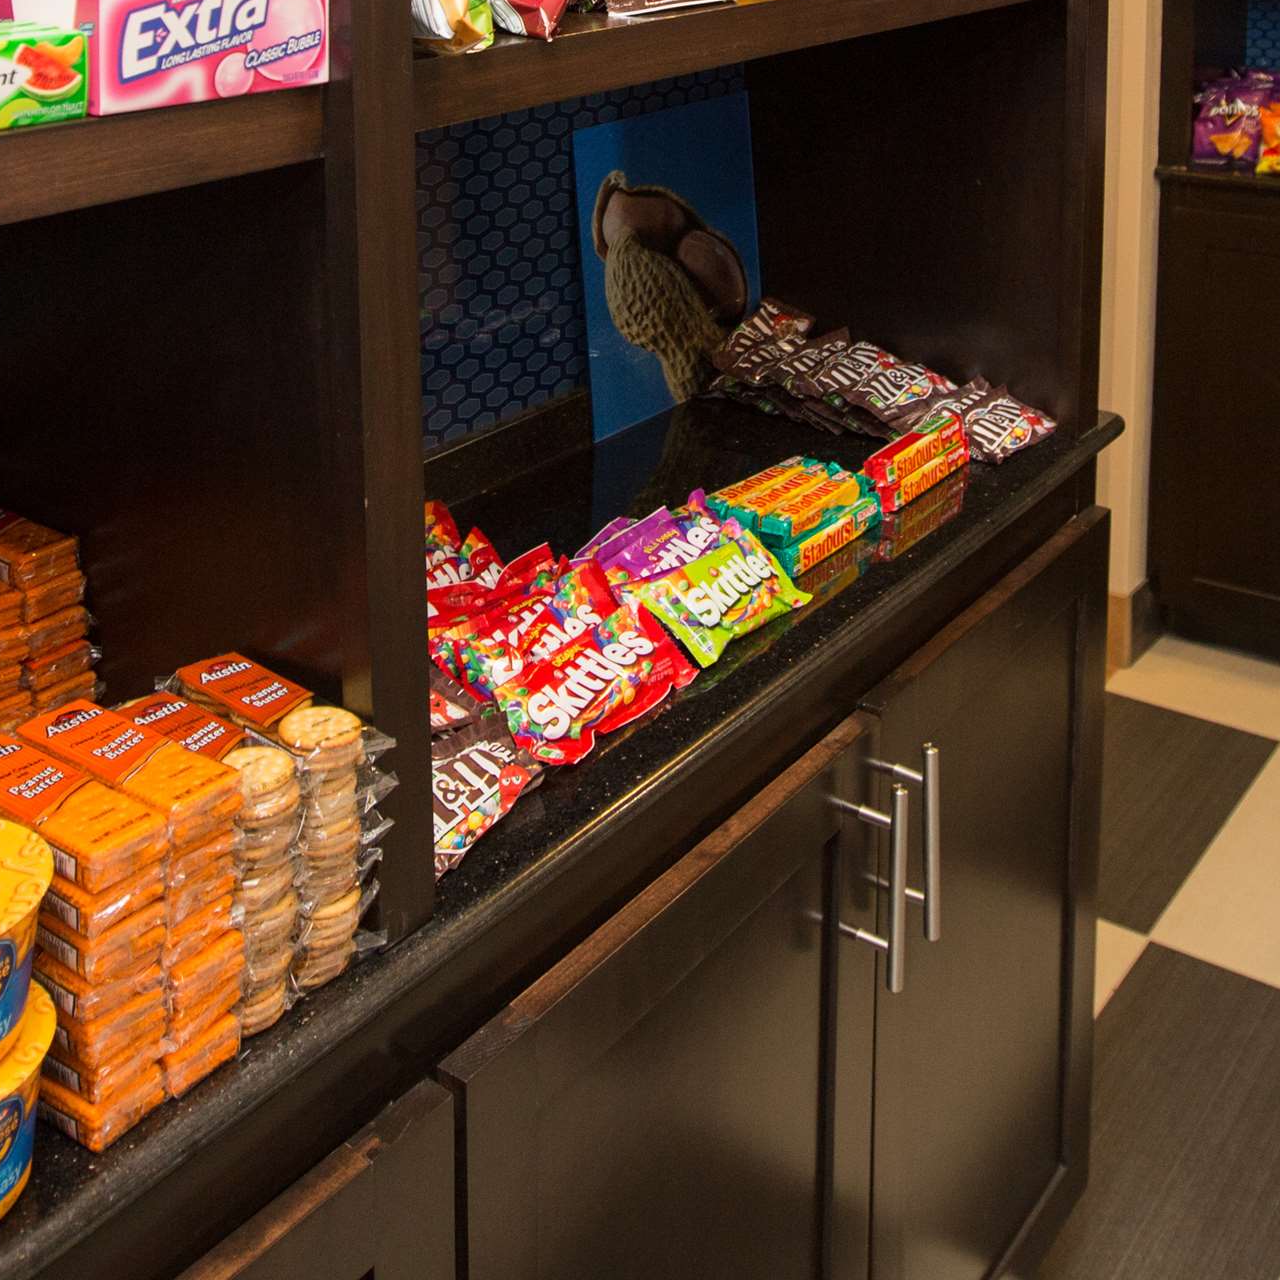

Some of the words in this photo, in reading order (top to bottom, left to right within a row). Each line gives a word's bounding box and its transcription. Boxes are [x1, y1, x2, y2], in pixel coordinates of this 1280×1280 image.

[161, 52, 186, 69] LONG
[186, 42, 221, 62] LASTING
[220, 31, 252, 51] FLAVOR
[245, 44, 286, 68] CLASSIC
[287, 31, 320, 54] BUBBLE
[895, 434, 942, 478] Starburst
[749, 471, 814, 508] Starburst
[903, 456, 949, 501] Starburst
[782, 480, 842, 516] Starburst
[803, 516, 856, 569] Starburst
[199, 660, 253, 685] Austin
[528, 630, 655, 740] Skittles
[241, 681, 281, 705] Peanut
[252, 684, 290, 709] Butter
[45, 707, 104, 739] Austin
[132, 699, 189, 728] Austin
[92, 726, 138, 758] Peanut
[104, 731, 146, 763] Butter
[178, 720, 220, 748] Peanut
[188, 724, 227, 753] Butter
[8, 765, 58, 797] Peanut
[22, 770, 65, 802] Butter
